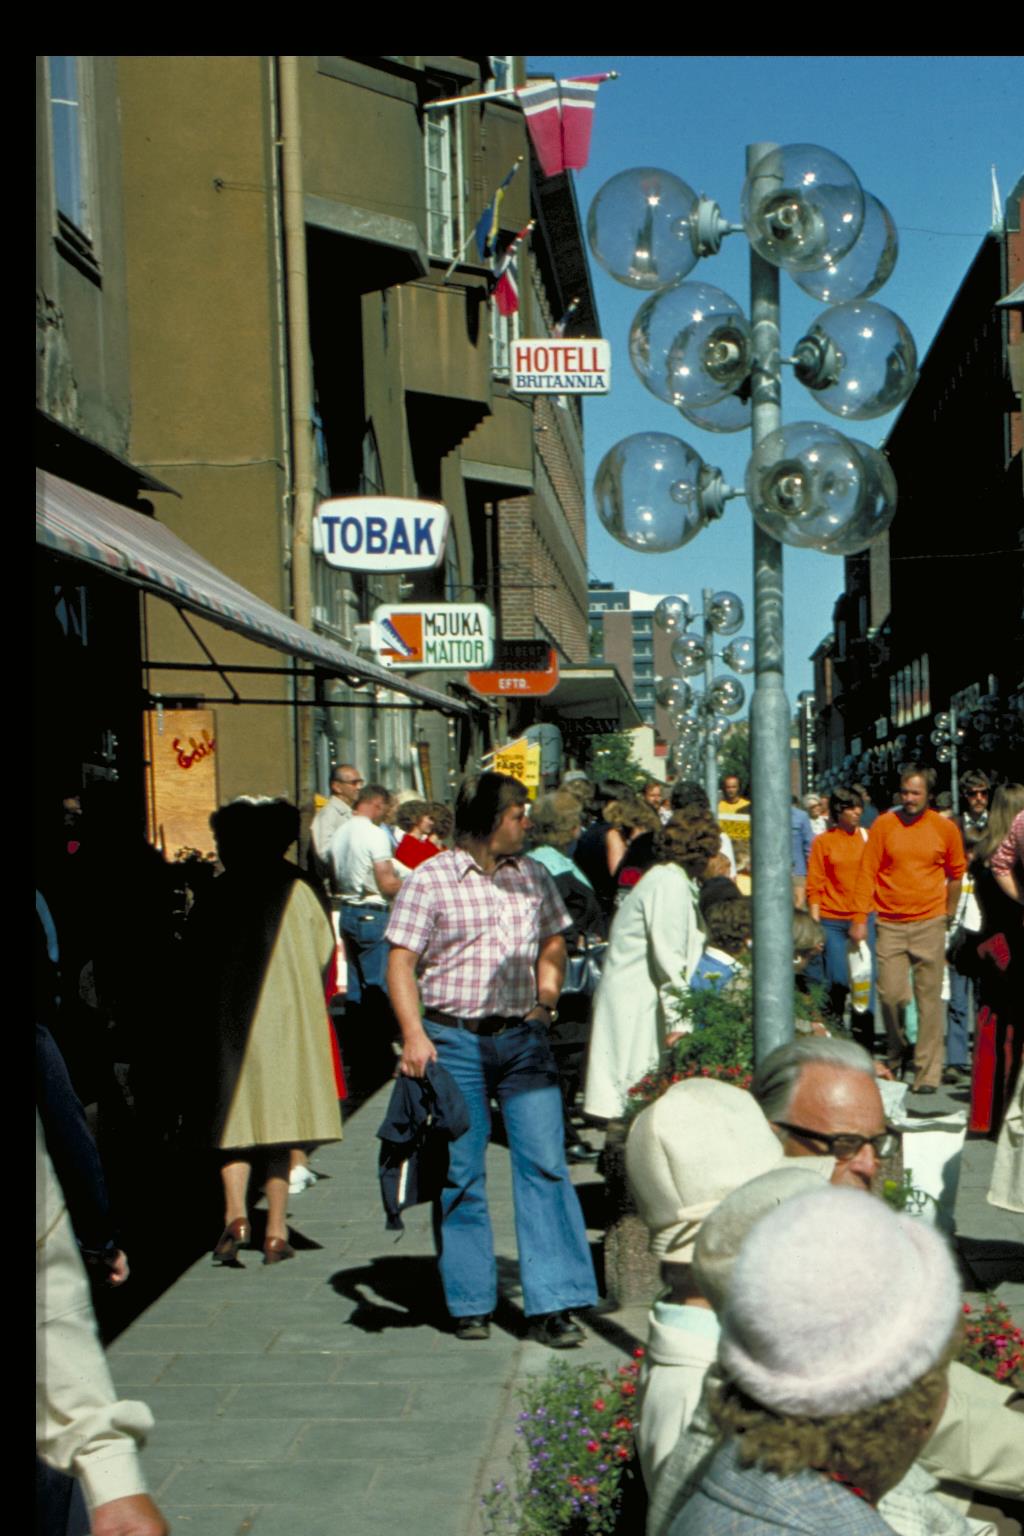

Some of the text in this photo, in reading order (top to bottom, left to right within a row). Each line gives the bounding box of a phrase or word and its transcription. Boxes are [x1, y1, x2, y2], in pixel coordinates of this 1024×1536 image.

[515, 346, 605, 373] HOTELL
[515, 375, 605, 388] BRITANNIA
[321, 516, 436, 555] TOBAK
[424, 612, 483, 636] MJUKA
[425, 640, 484, 663] MATTOR
[498, 679, 530, 690] EFTR.
